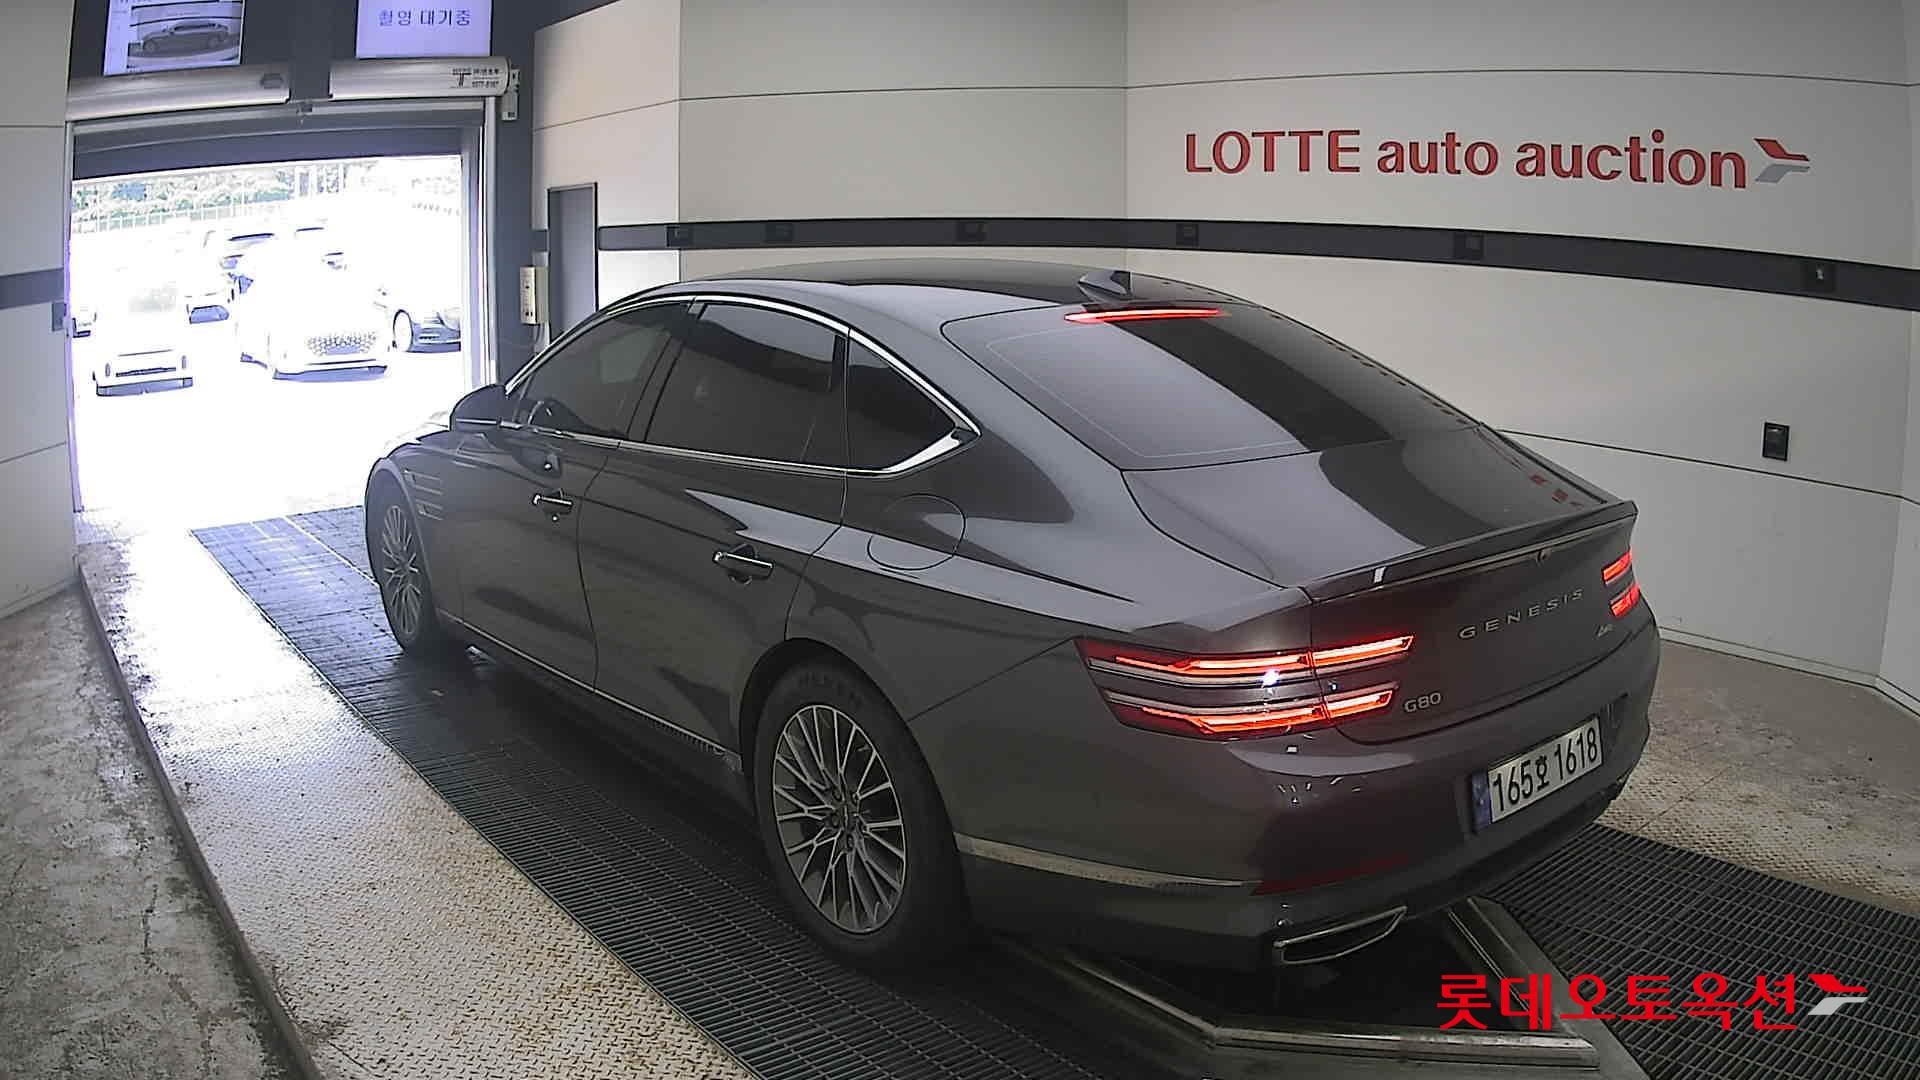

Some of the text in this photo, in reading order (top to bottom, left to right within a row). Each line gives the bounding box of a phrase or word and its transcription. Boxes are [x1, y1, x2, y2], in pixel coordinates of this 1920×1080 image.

[420, 9, 470, 26] 대기중
[1186, 129, 1746, 188] LOTTE auto auction
[1459, 588, 1583, 639] GENESIS
[1404, 692, 1441, 712] G80
[1554, 727, 1598, 780] 1618
